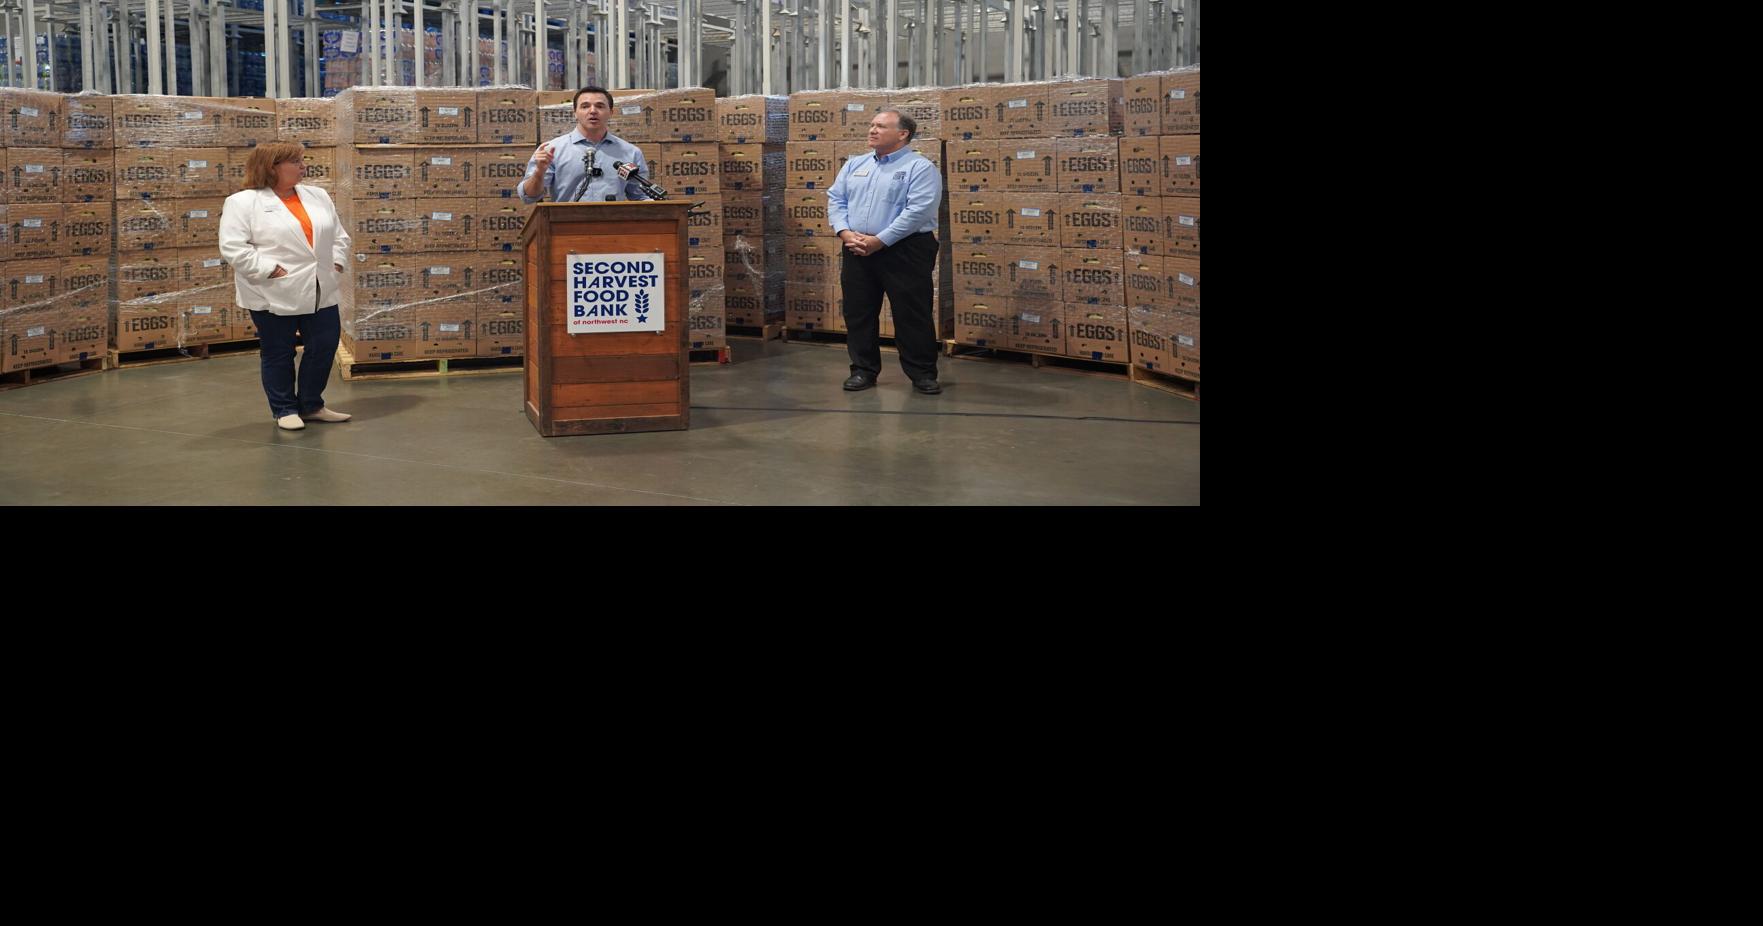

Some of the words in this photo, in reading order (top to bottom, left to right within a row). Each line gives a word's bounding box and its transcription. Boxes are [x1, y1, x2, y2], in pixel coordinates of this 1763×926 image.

[1060, 101, 1097, 116] EGGS
[1130, 98, 1152, 113] EGGS
[489, 109, 525, 123] EGGS
[669, 108, 704, 121] EGGS
[726, 114, 756, 125] EGGS
[798, 111, 828, 123] EGGS
[951, 106, 982, 120] EGGS
[237, 115, 268, 128] EGGS
[489, 163, 526, 177] EGGS
[673, 162, 708, 176] EGGS
[723, 161, 752, 173] EGGS
[795, 159, 826, 171] EGGS
[958, 159, 990, 172] EGGS
[1069, 157, 1107, 171] EGGS
[1128, 158, 1152, 173] EGGS
[365, 165, 402, 179] EGGS
[724, 206, 753, 218] EGGS
[794, 206, 824, 218] EGGS
[960, 210, 993, 224] EGGS
[490, 216, 525, 230] EGGS
[1072, 212, 1111, 227] EGGS
[1130, 216, 1155, 232] EGGS
[72, 222, 103, 236] EGGS
[795, 253, 825, 265] EGGS
[132, 267, 168, 280] EGGS
[573, 261, 654, 274] SECOND
[689, 265, 714, 278] GGS
[963, 261, 995, 276] EGGS
[71, 274, 101, 290] EGGS
[574, 275, 658, 288] HARVEST
[1073, 269, 1112, 284] EGGS
[1132, 273, 1157, 292] EGGS
[574, 290, 629, 303] FOOD
[726, 296, 755, 308] EGGS
[574, 304, 627, 317] BANK
[794, 299, 825, 312] EGGS
[132, 316, 168, 332] EGGS
[964, 312, 997, 328] EGGS
[69, 325, 99, 342] EGGS
[1077, 323, 1115, 340] EGGS
[1136, 330, 1160, 350] EGGS
